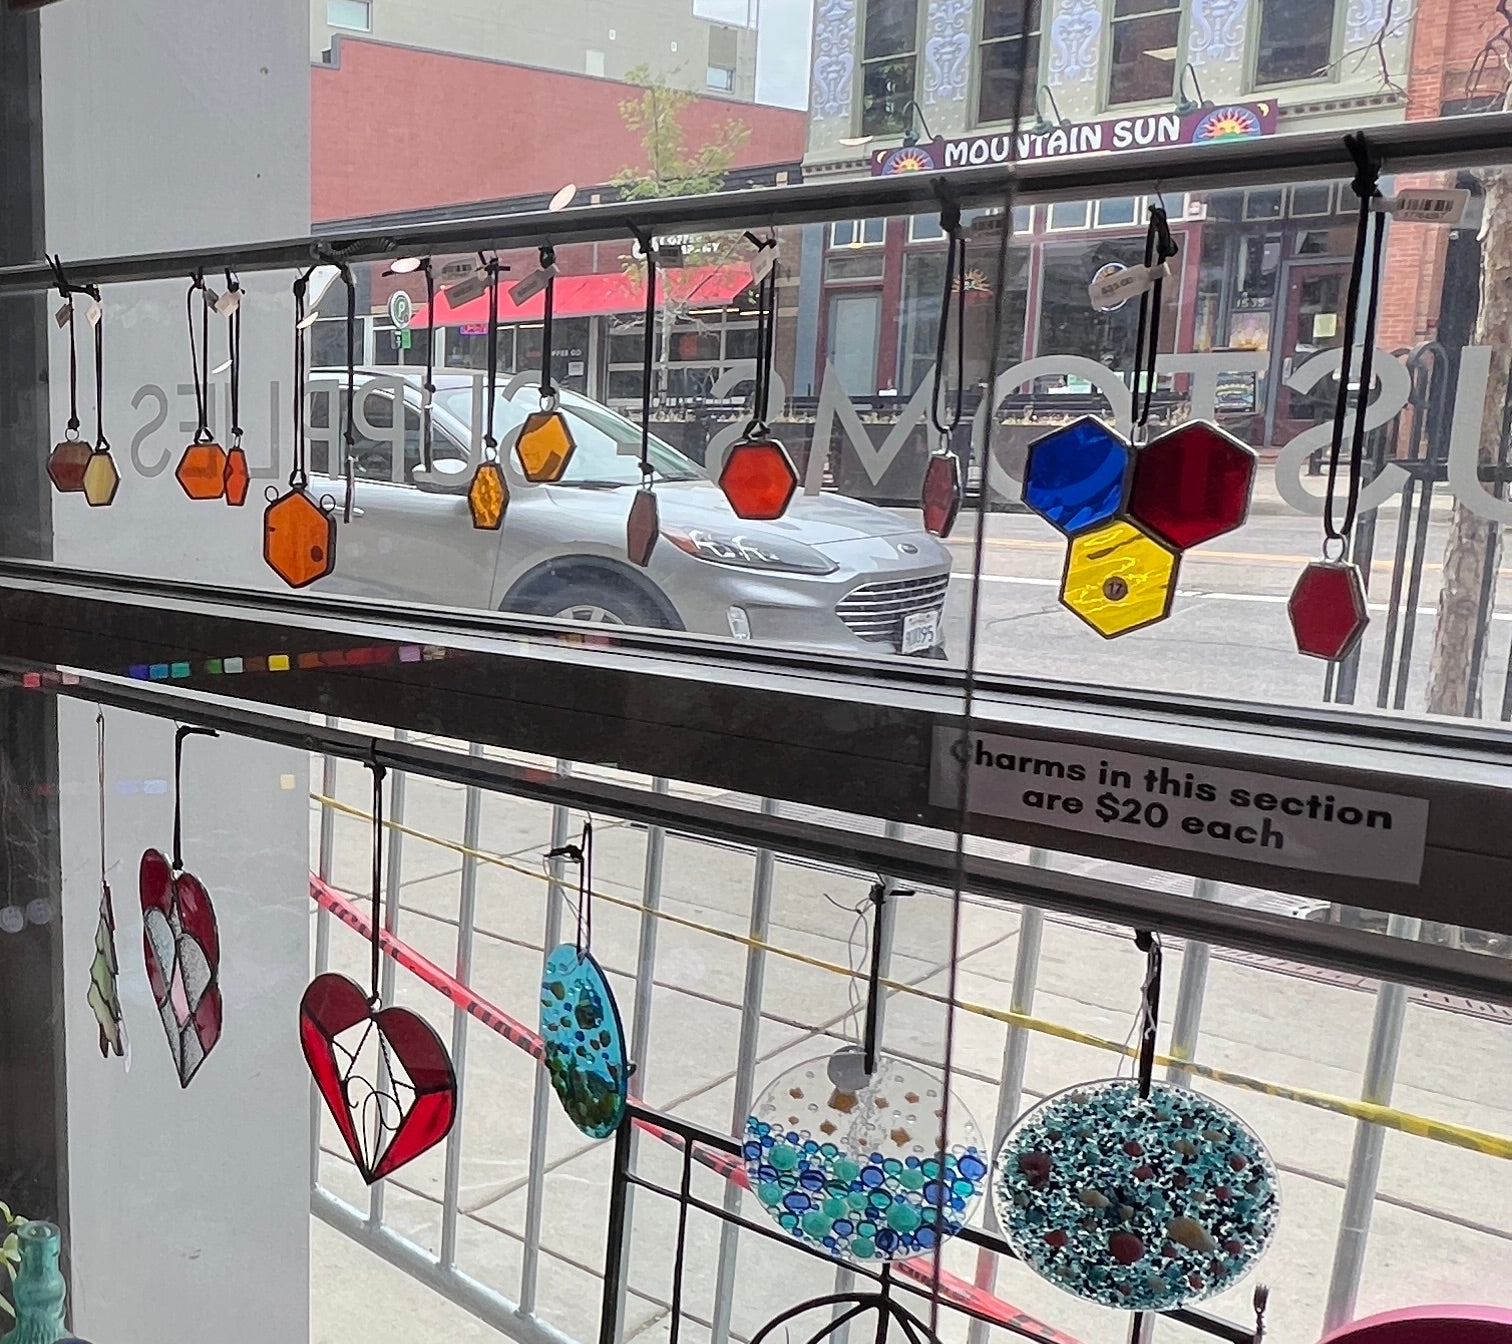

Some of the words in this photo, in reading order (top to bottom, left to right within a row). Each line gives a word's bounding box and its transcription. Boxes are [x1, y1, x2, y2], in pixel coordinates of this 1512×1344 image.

[944, 124, 1102, 168] MOUNTAIN
[1111, 115, 1181, 148] SUN
[1022, 789, 1084, 814] are
[1096, 792, 1169, 829] $20
[1181, 815, 1284, 850] each
[1099, 761, 1132, 790] in
[1144, 766, 1217, 803] this
[1229, 785, 1394, 830] section
